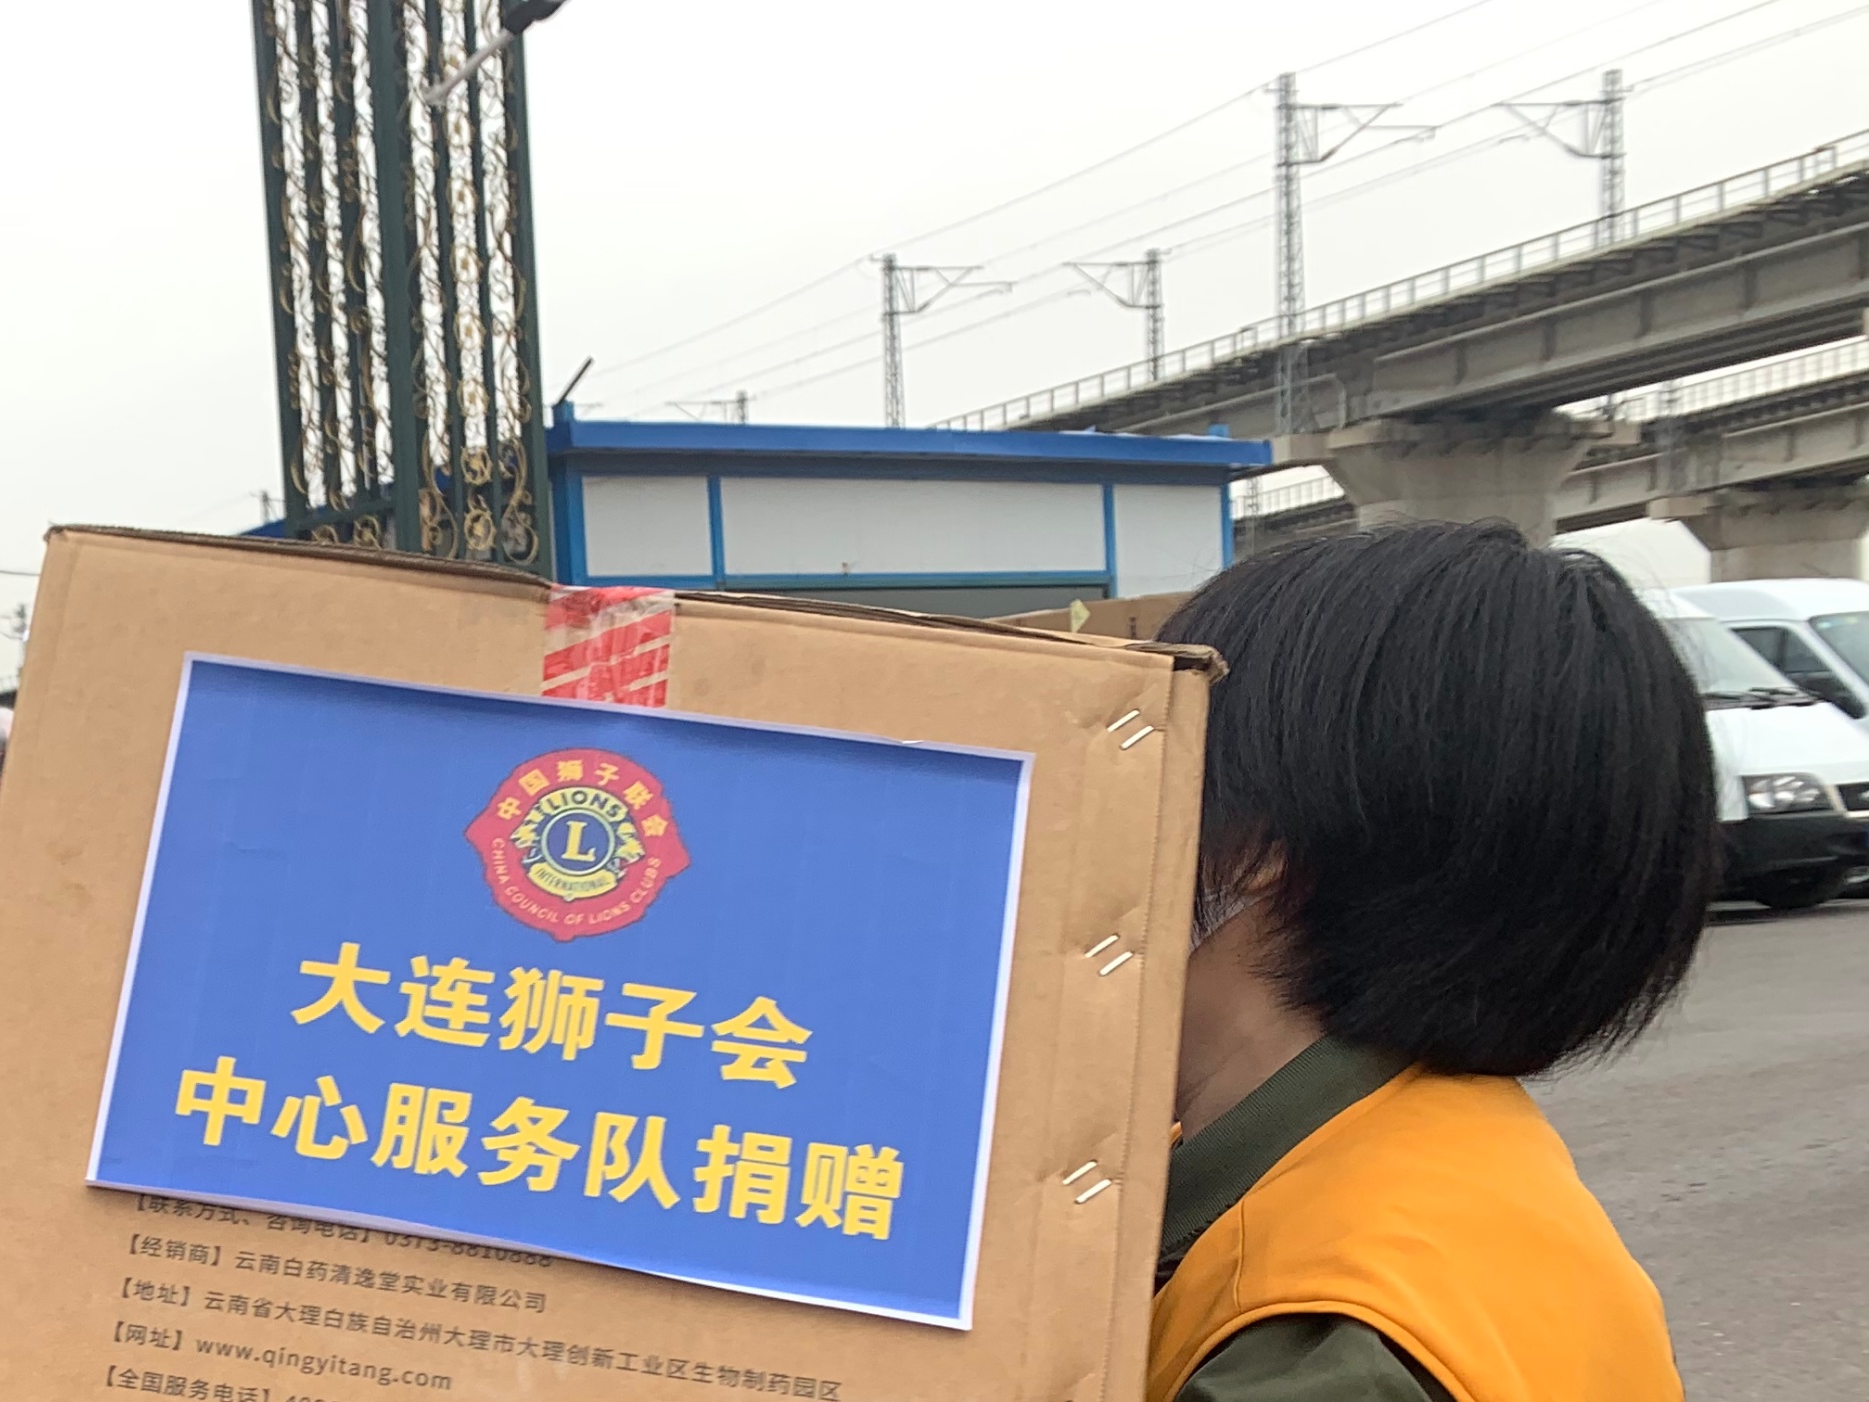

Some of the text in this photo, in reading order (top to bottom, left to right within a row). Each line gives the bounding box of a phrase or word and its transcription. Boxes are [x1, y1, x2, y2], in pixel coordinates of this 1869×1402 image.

[546, 790, 622, 817] LIONS
[562, 821, 596, 862] L
[492, 837, 661, 925] CHINA COUNCIL OF LIONS CLUBS
[291, 941, 813, 1089] 大连狮子会
[175, 1056, 905, 1240] 中心服务队捐赠
